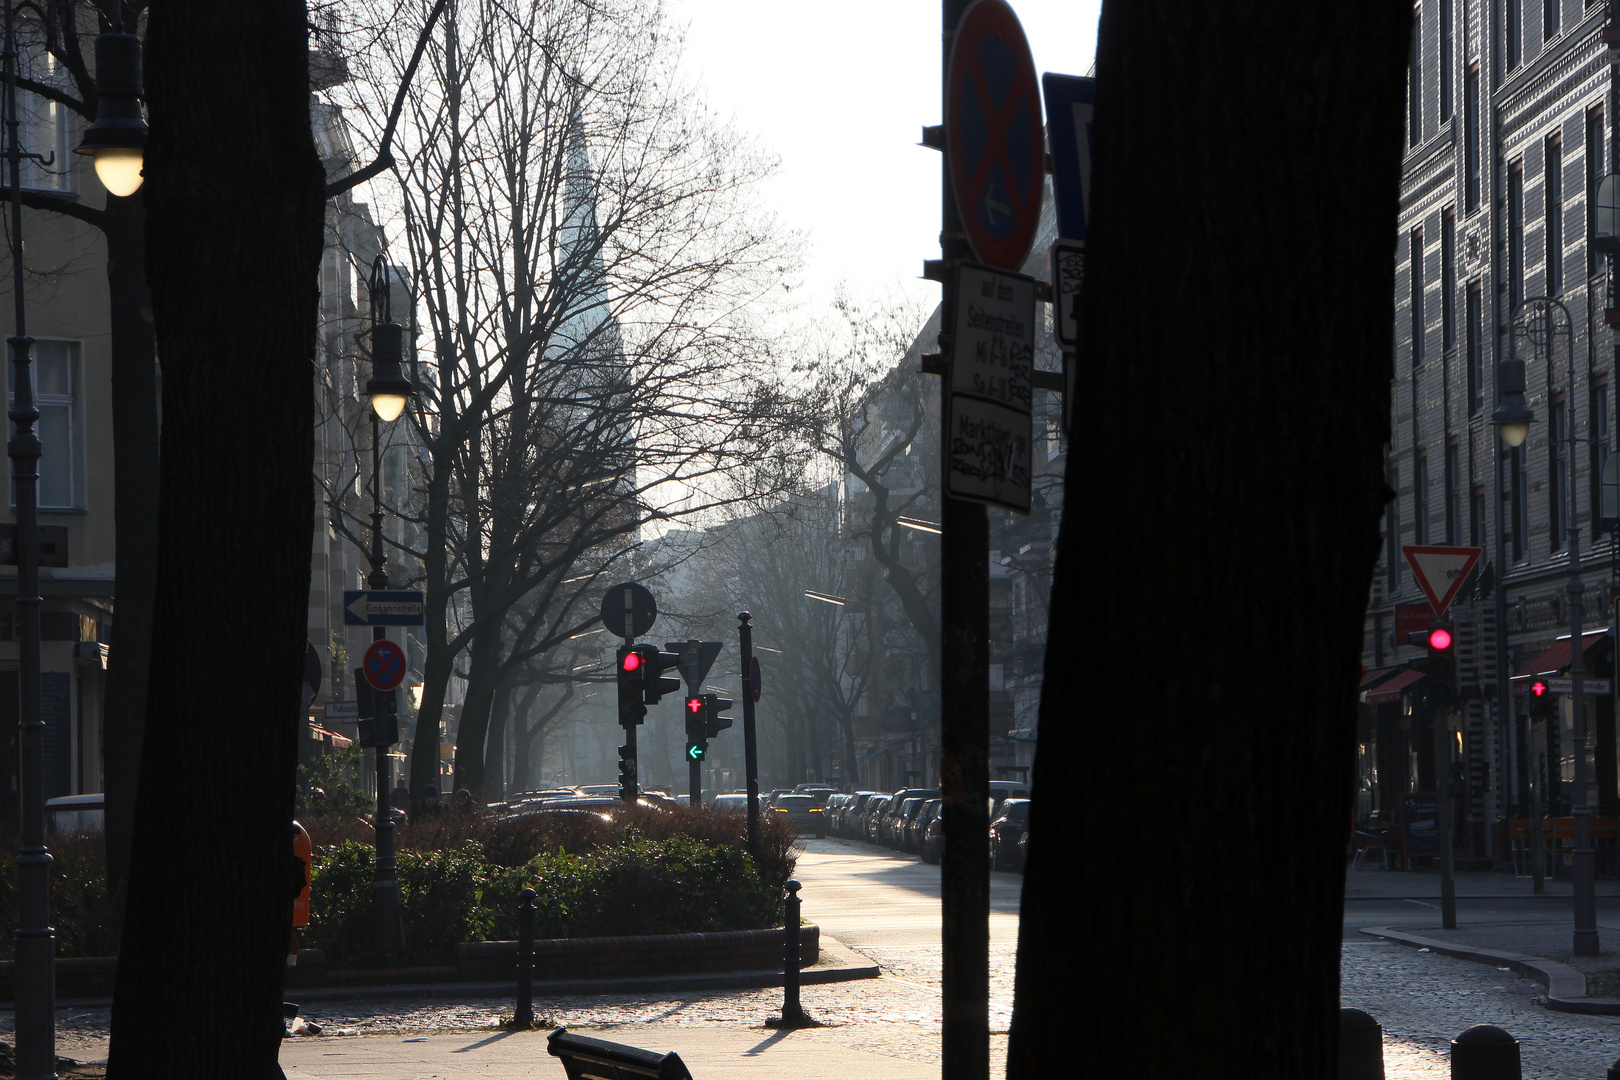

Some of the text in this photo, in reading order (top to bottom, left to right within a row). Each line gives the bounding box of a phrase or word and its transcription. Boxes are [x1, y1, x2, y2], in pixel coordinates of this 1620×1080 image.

[981, 276, 1013, 303] auf dem
[967, 304, 1024, 339] Seitenstreifen
[976, 340, 988, 363] Mi
[367, 604, 421, 614] Einbahnstraße
